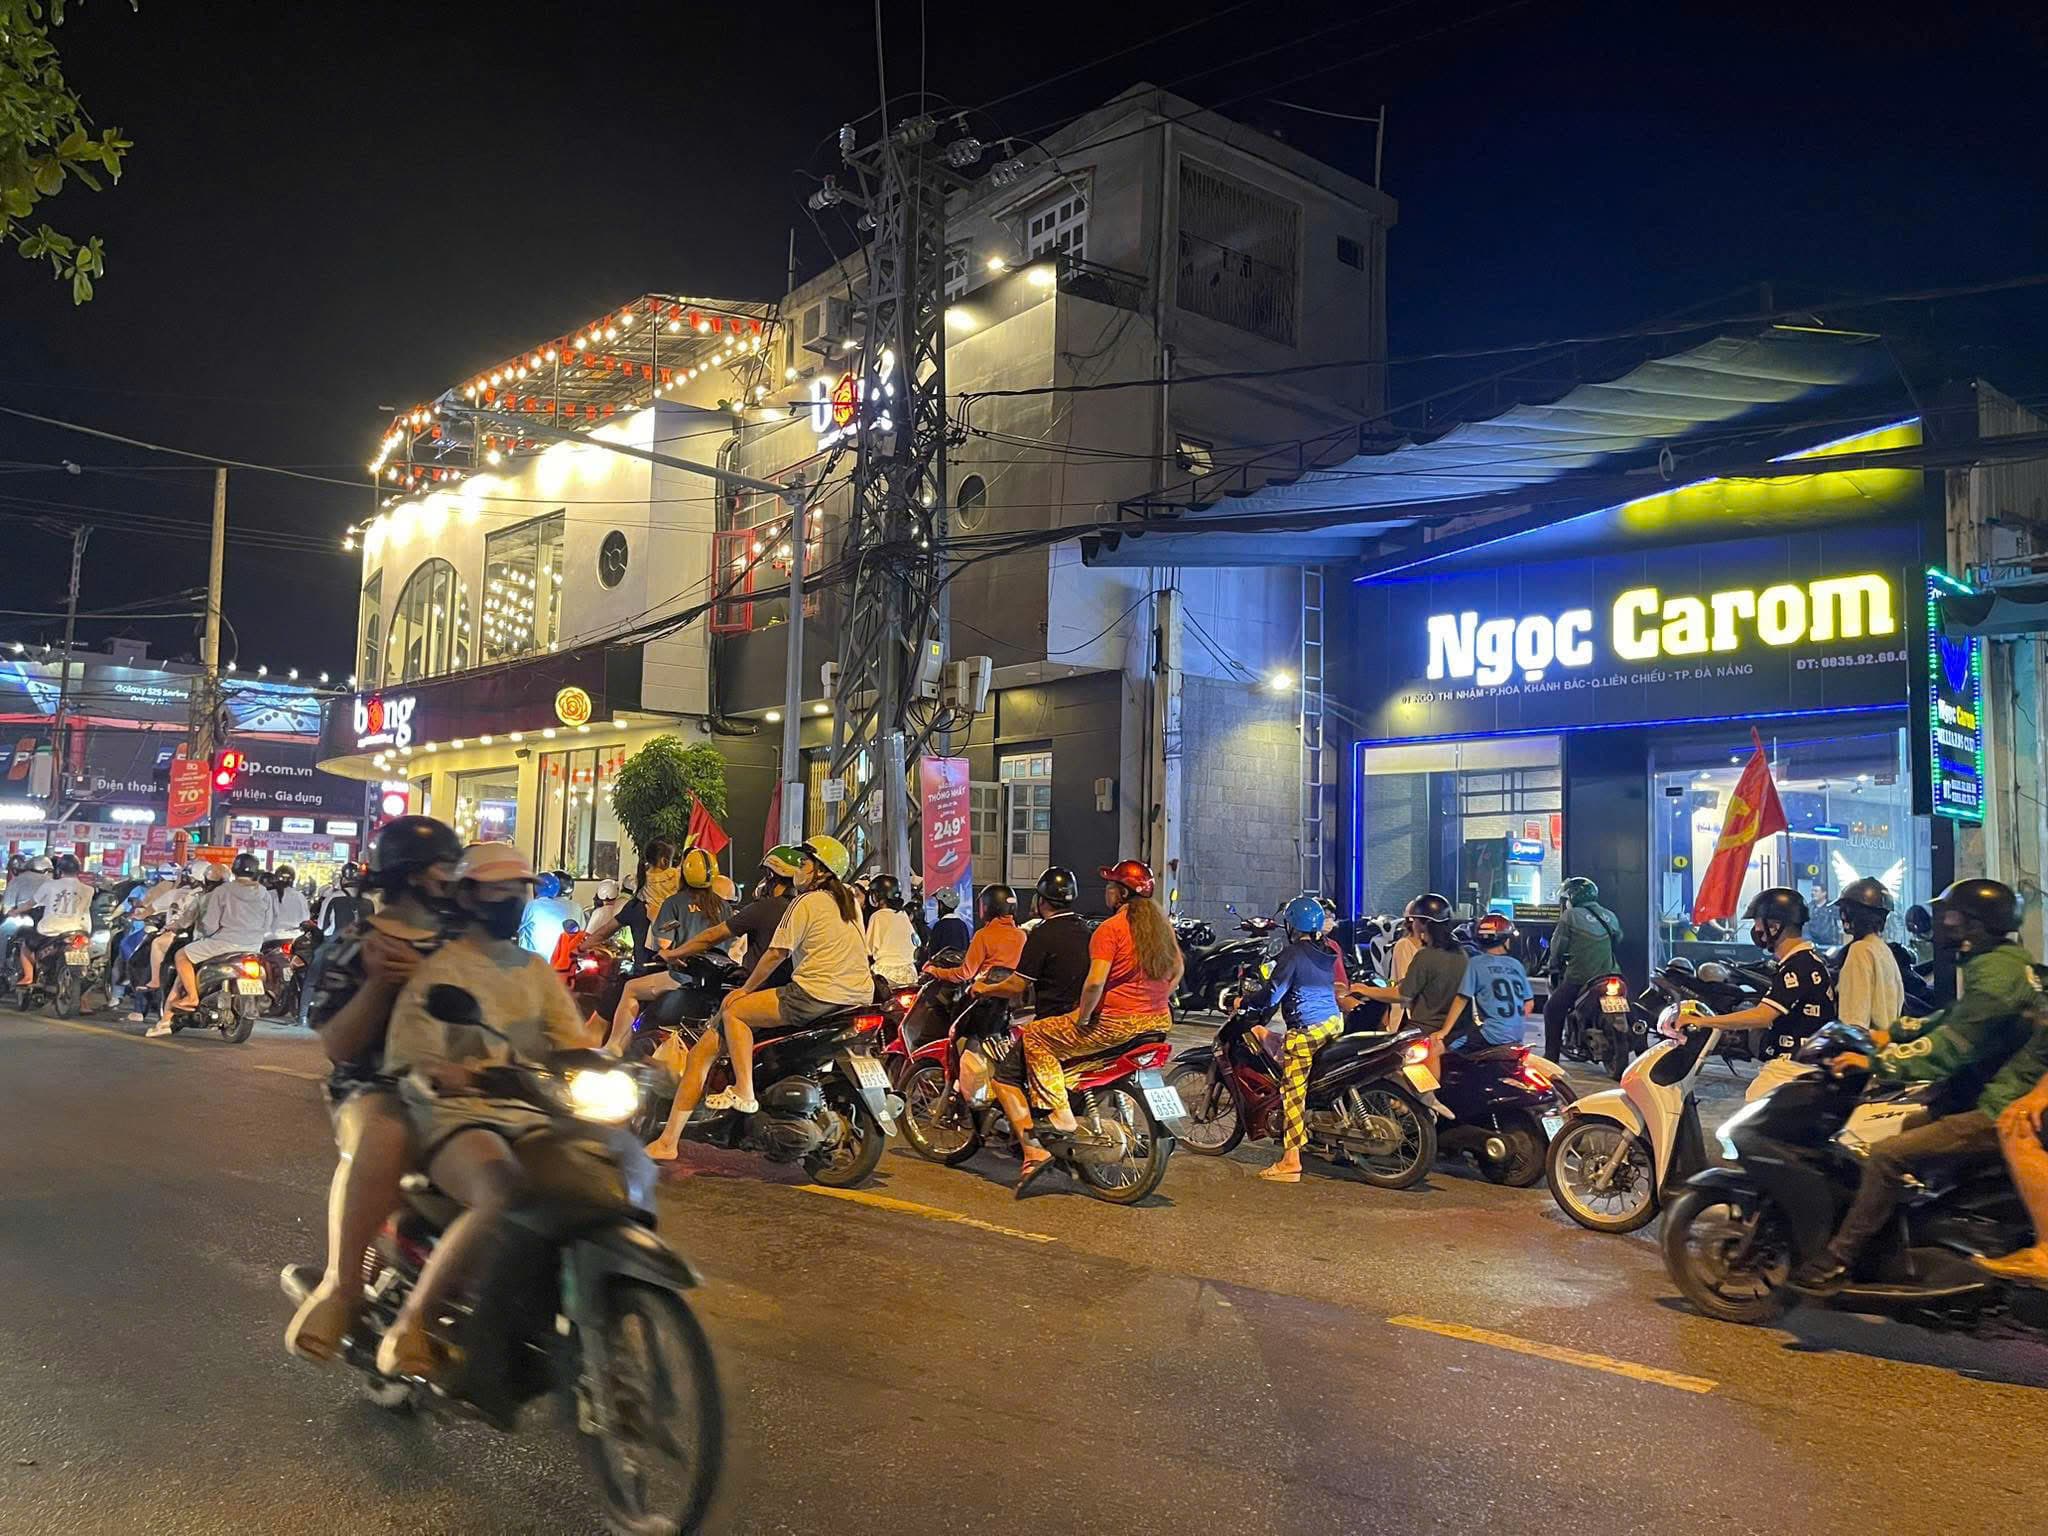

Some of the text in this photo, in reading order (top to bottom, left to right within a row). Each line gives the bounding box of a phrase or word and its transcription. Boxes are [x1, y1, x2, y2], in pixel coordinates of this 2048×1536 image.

[1427, 573, 1895, 686] Ngọc Carom
[295, 791, 322, 806] dụng
